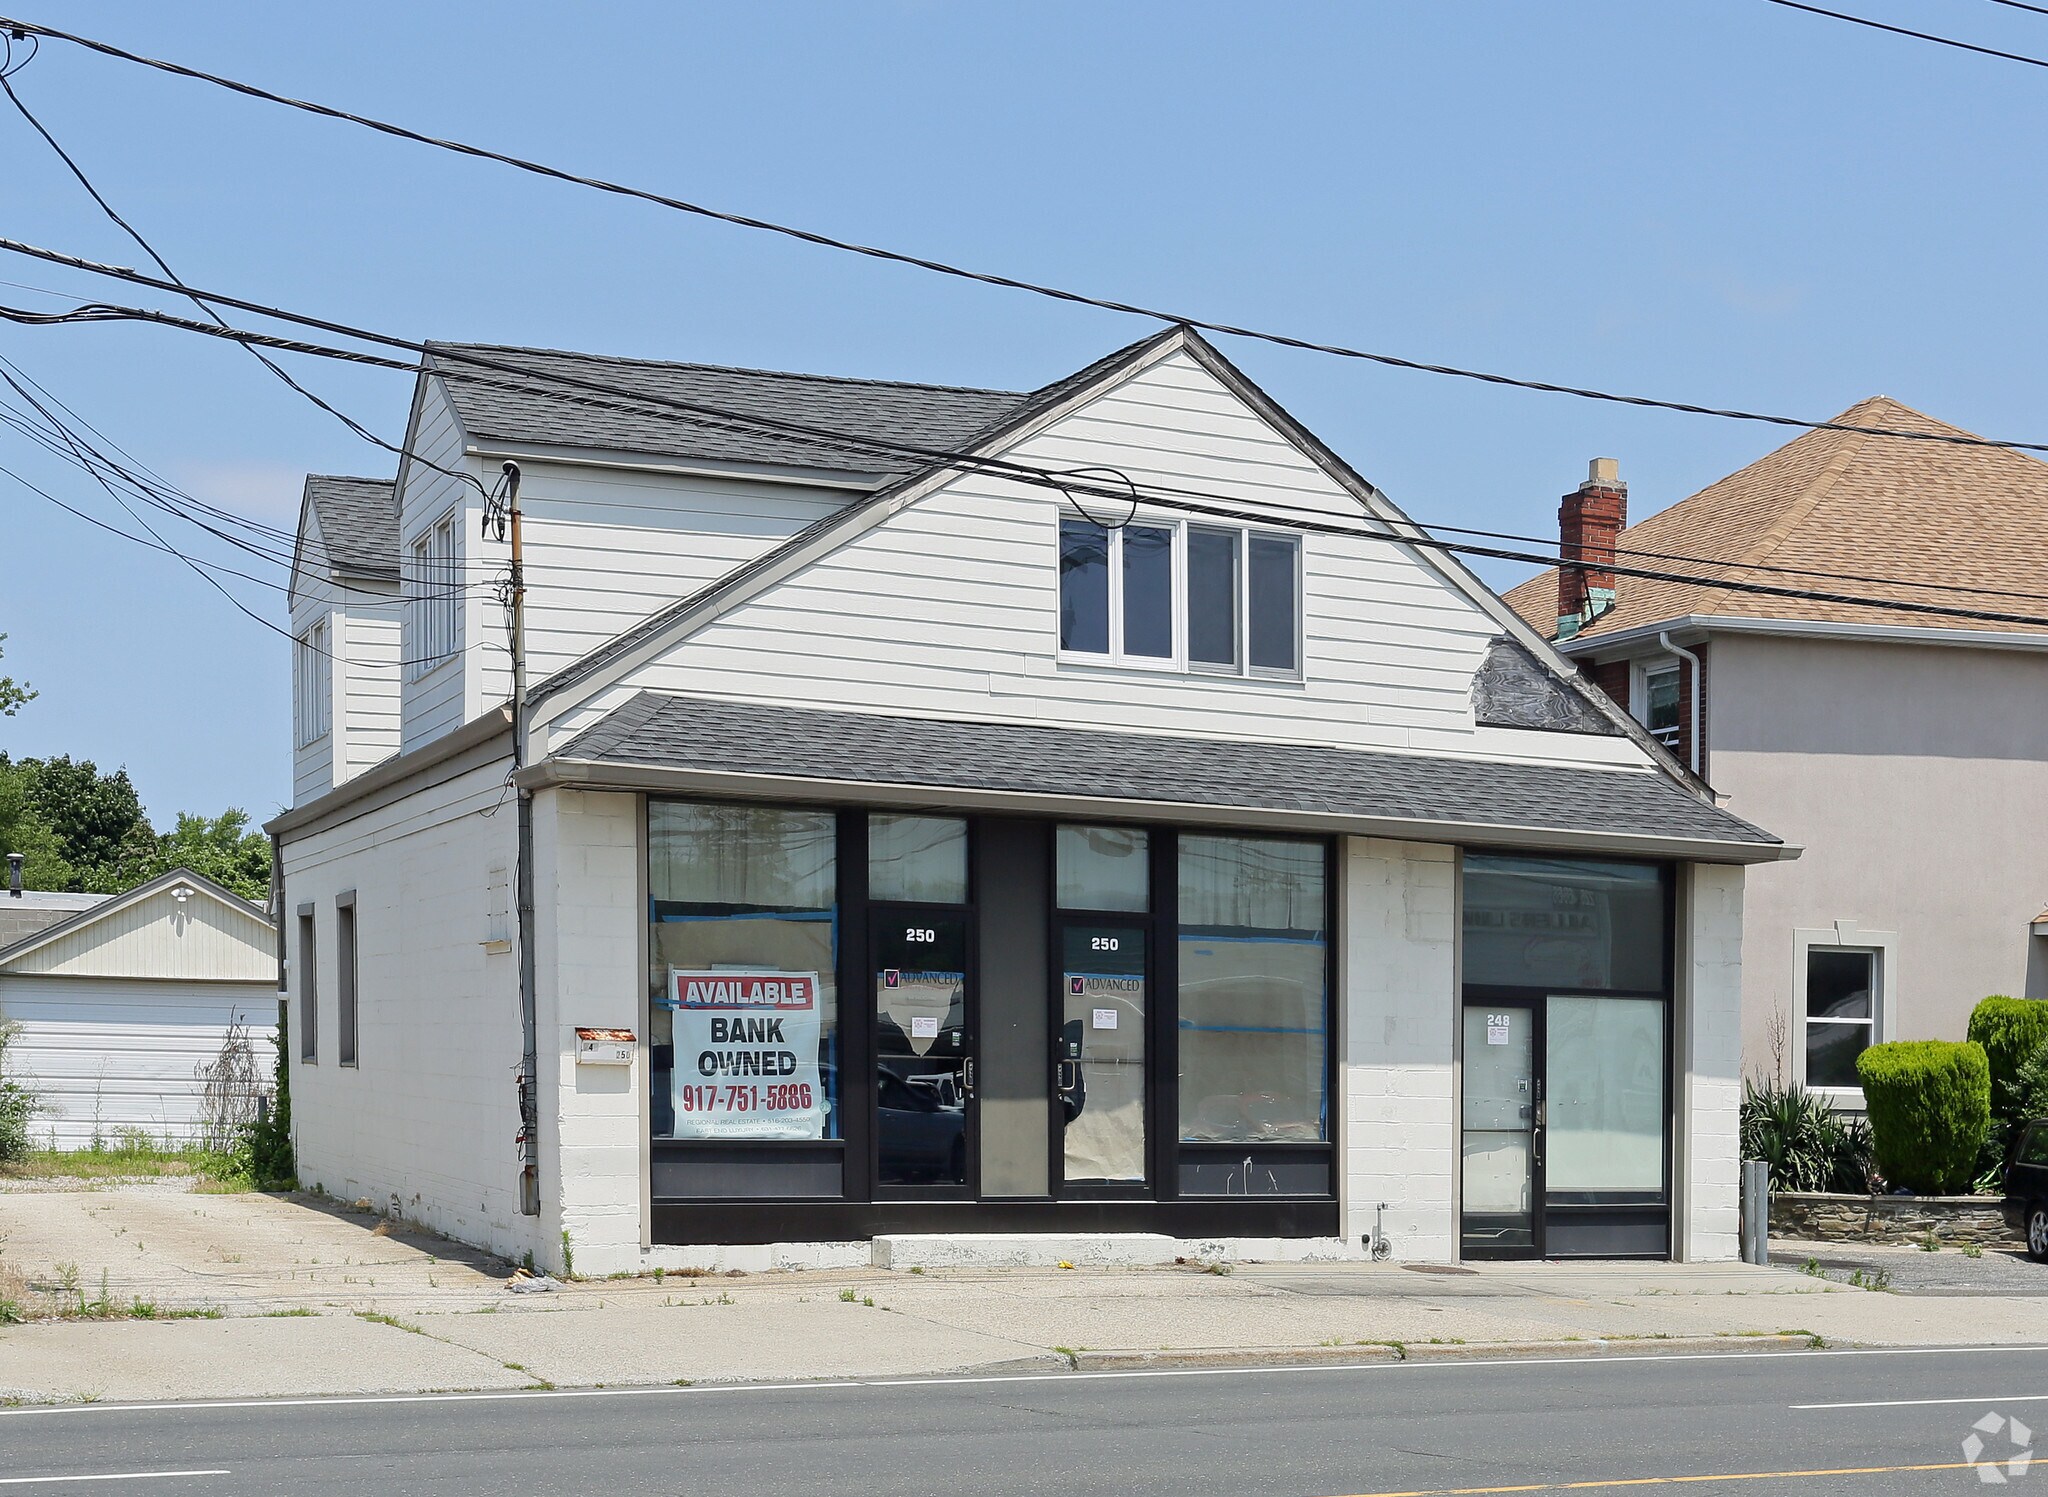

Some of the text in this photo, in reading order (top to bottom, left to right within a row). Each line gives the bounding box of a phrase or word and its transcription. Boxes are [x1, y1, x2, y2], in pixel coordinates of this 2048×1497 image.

[906, 928, 935, 942] 250
[1091, 937, 1119, 951] 250
[900, 972, 958, 985] ADVANCED
[1085, 977, 1140, 992] ADVANCED
[686, 982, 807, 1004] AVAILABLE
[1487, 1014, 1510, 1026] 248
[711, 1018, 785, 1043] BANK
[698, 1051, 797, 1076] OWNED
[683, 1084, 812, 1112] 917-751-5886
